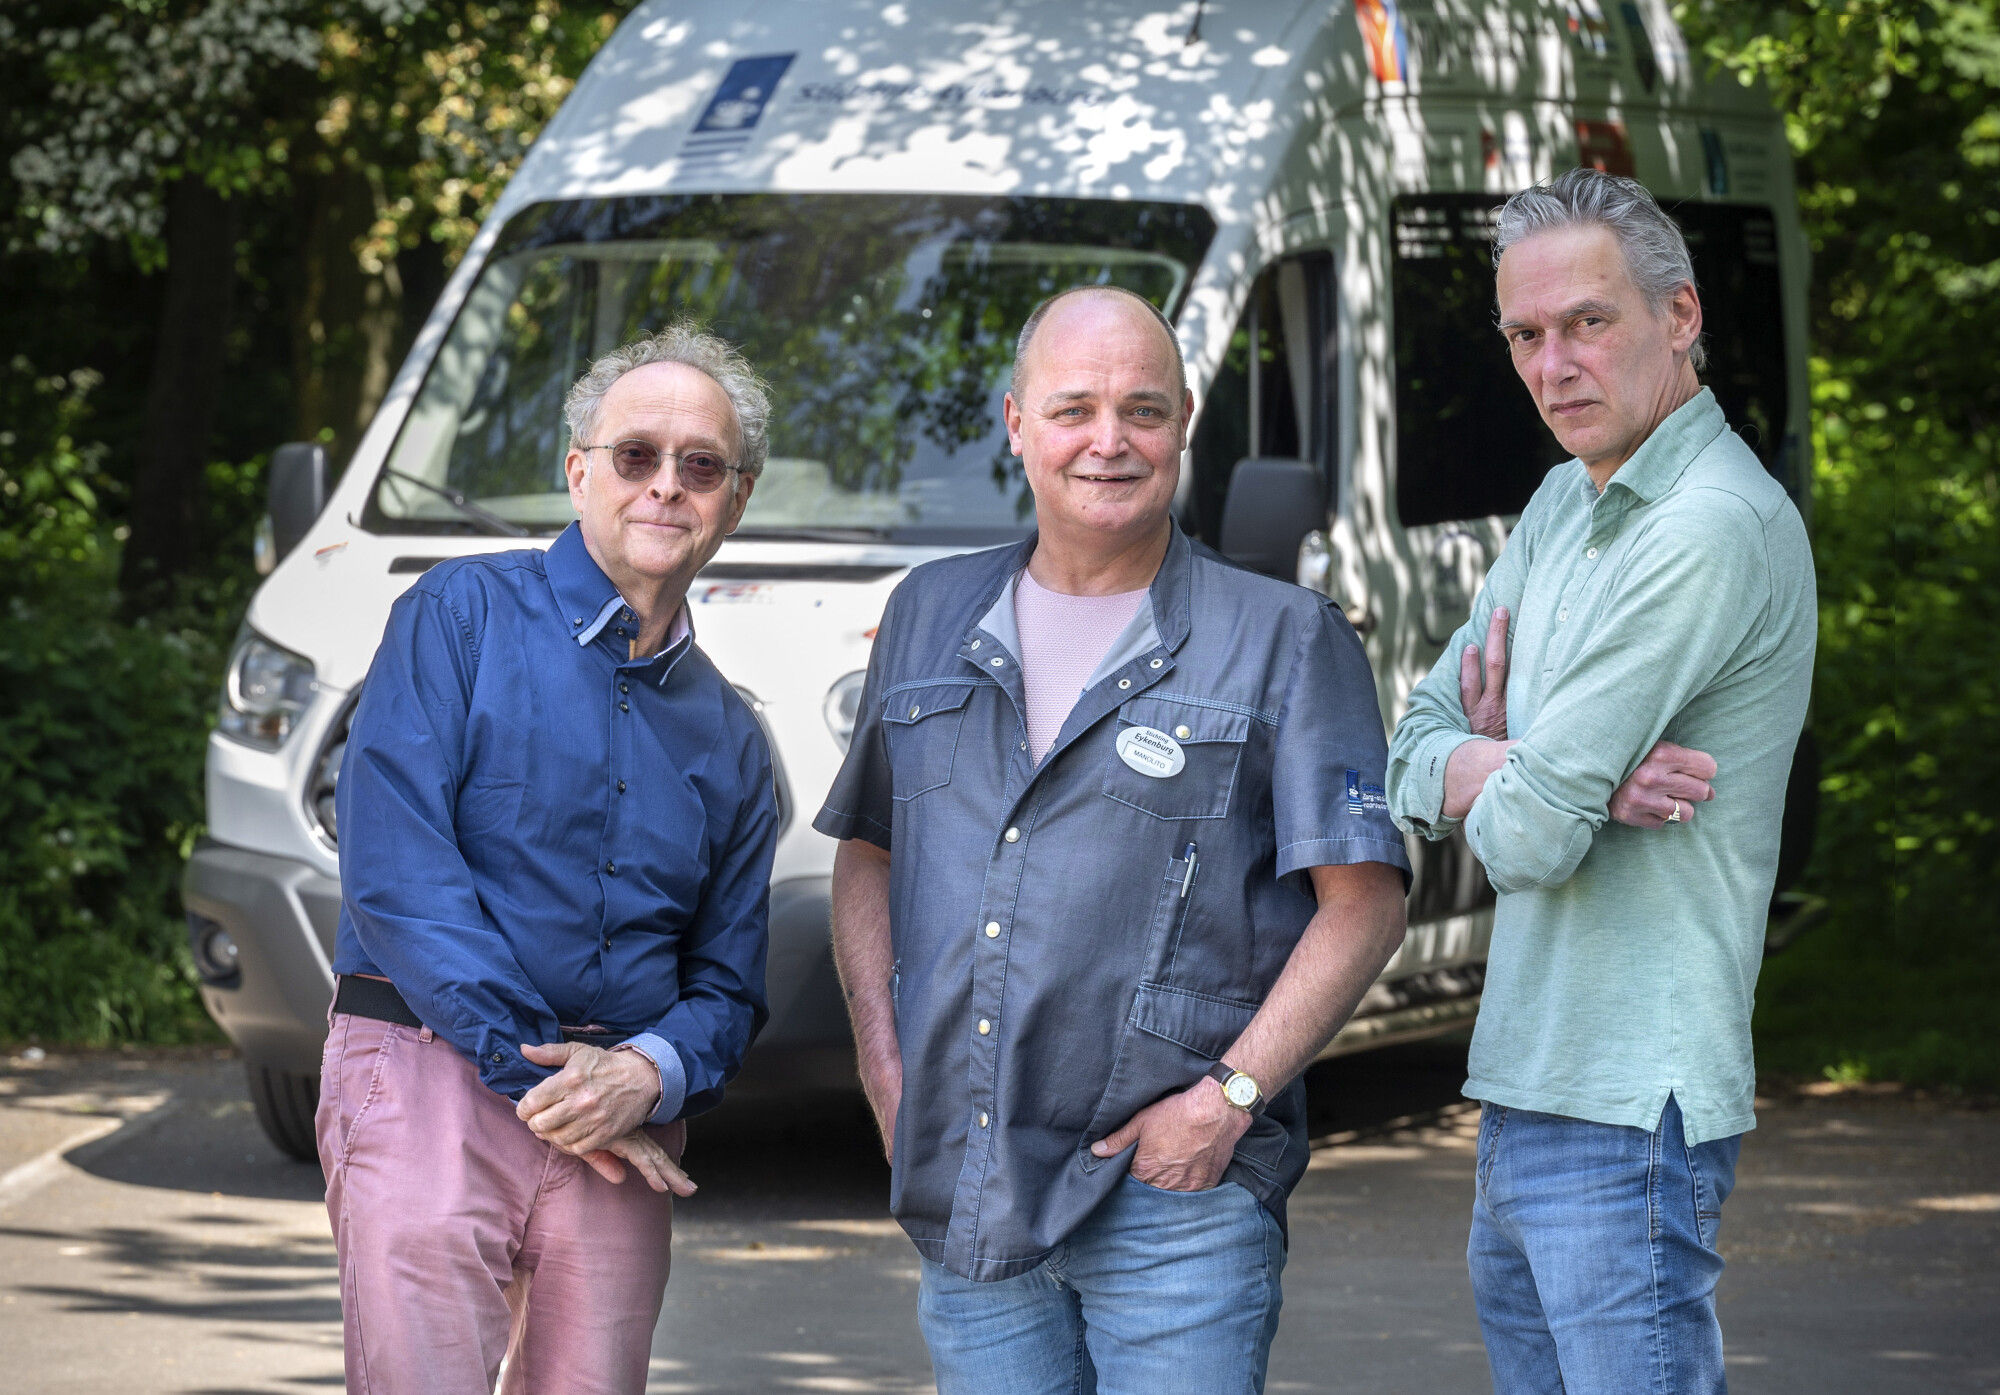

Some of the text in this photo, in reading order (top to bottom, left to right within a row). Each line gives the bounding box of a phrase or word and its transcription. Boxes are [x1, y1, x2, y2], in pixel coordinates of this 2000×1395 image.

[1134, 733, 1174, 755] Eykenburg
[1146, 730, 1169, 744] Stichting
[1134, 750, 1165, 768] MANOLITO
